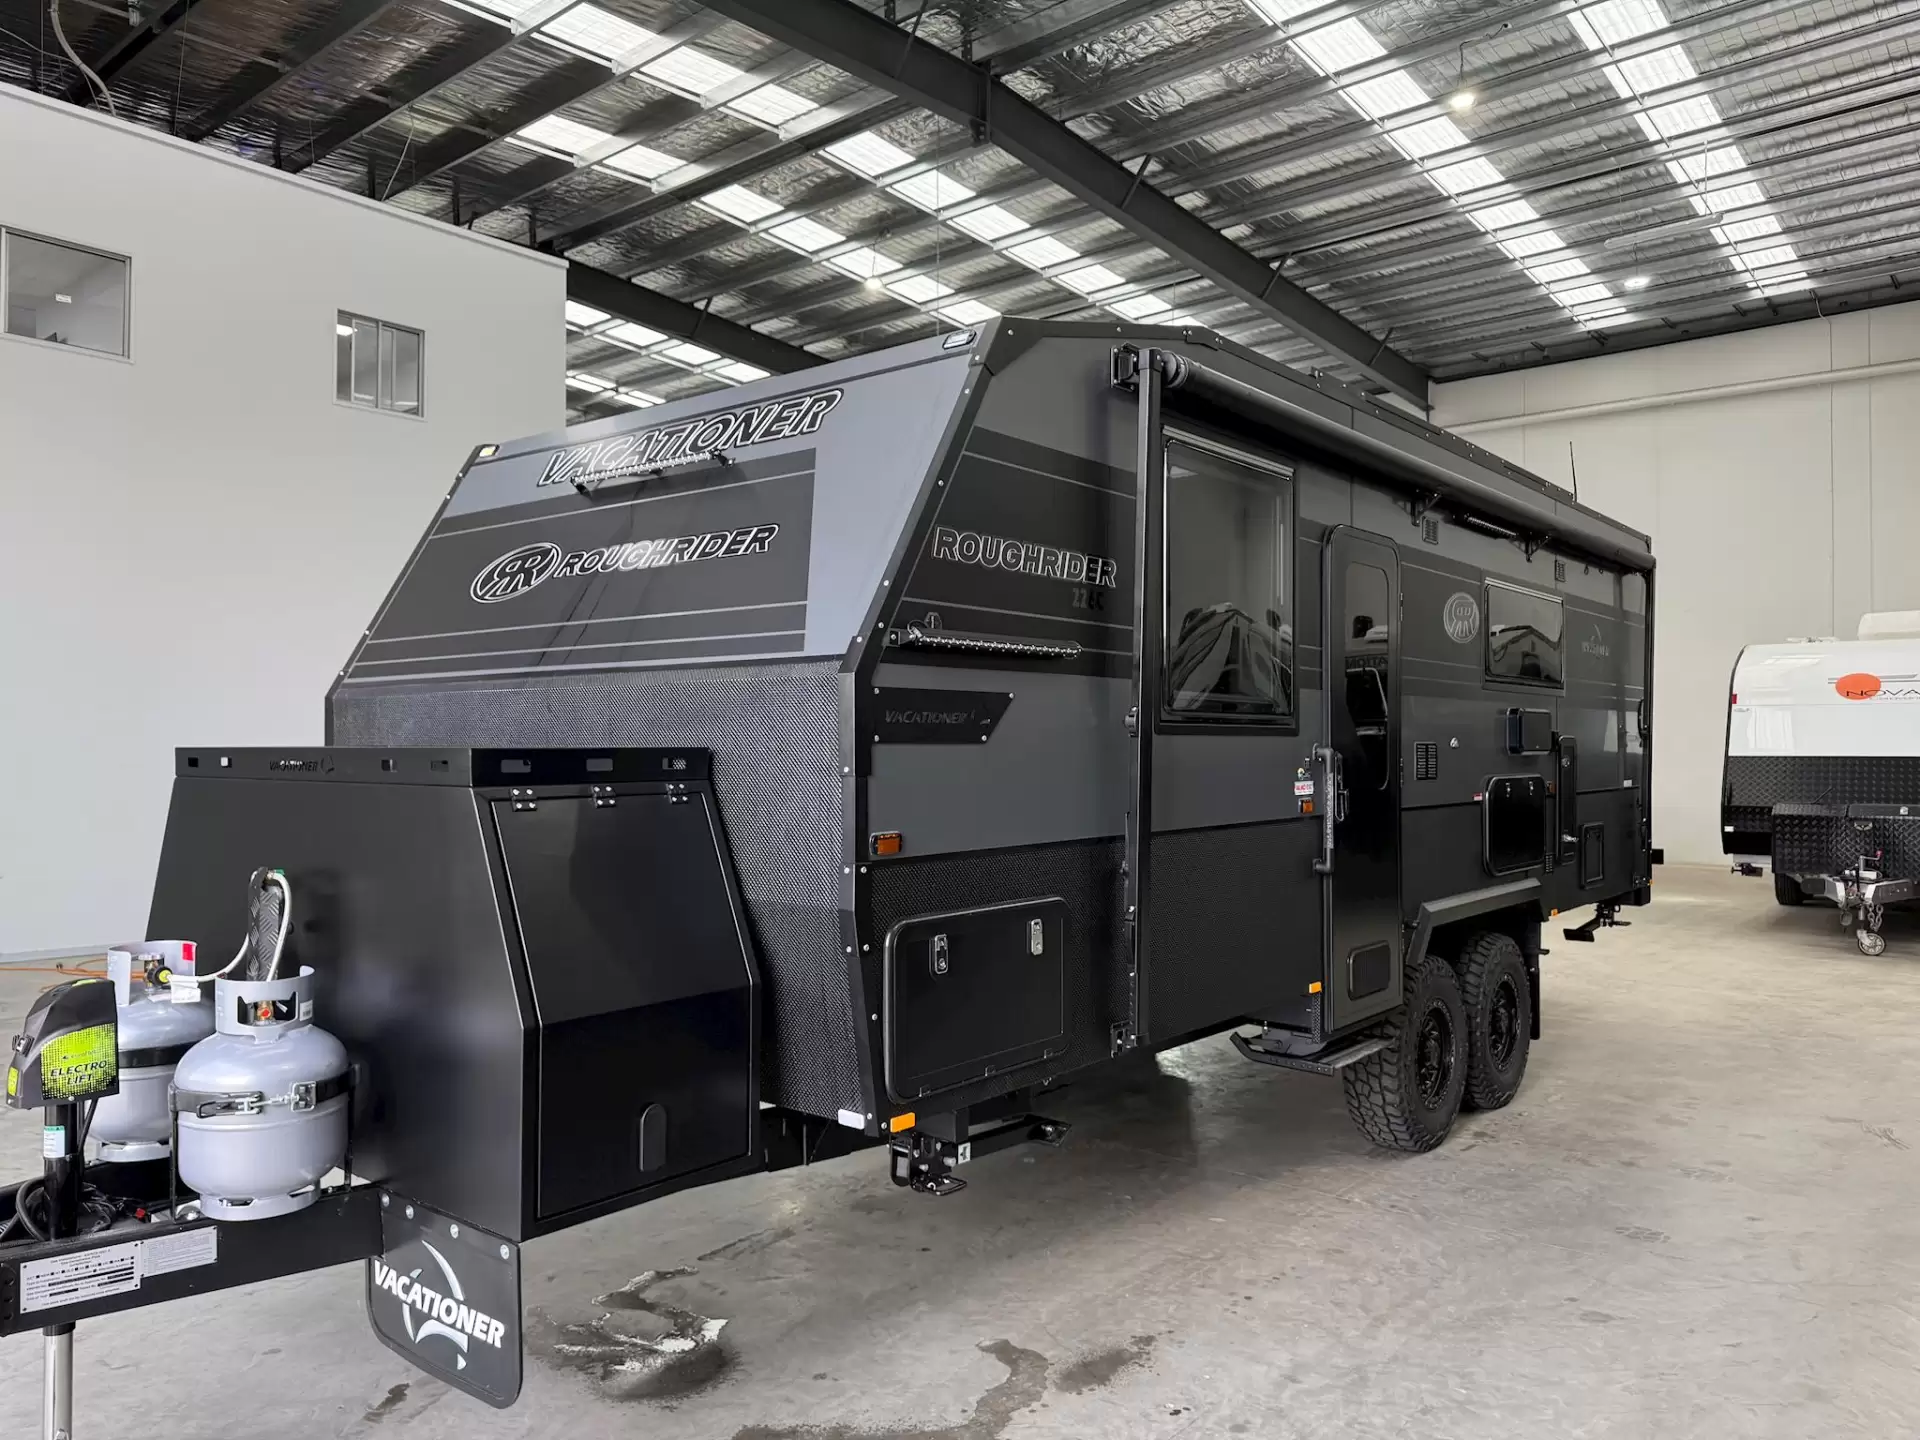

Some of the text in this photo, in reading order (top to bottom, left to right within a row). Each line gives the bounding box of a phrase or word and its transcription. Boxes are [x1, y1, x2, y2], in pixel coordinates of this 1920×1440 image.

[535, 388, 845, 488] VACATIONER
[553, 524, 780, 578] ROUGHRIDER
[933, 526, 1117, 588] ROUGHRIDER
[1846, 689, 1920, 697] NOVA
[885, 709, 968, 724] VACATIONER
[269, 760, 319, 773] VACATIONER
[50, 1060, 107, 1077] ELECTRO
[67, 1073, 93, 1085] LIFT
[374, 1260, 505, 1348] VACATIONER
